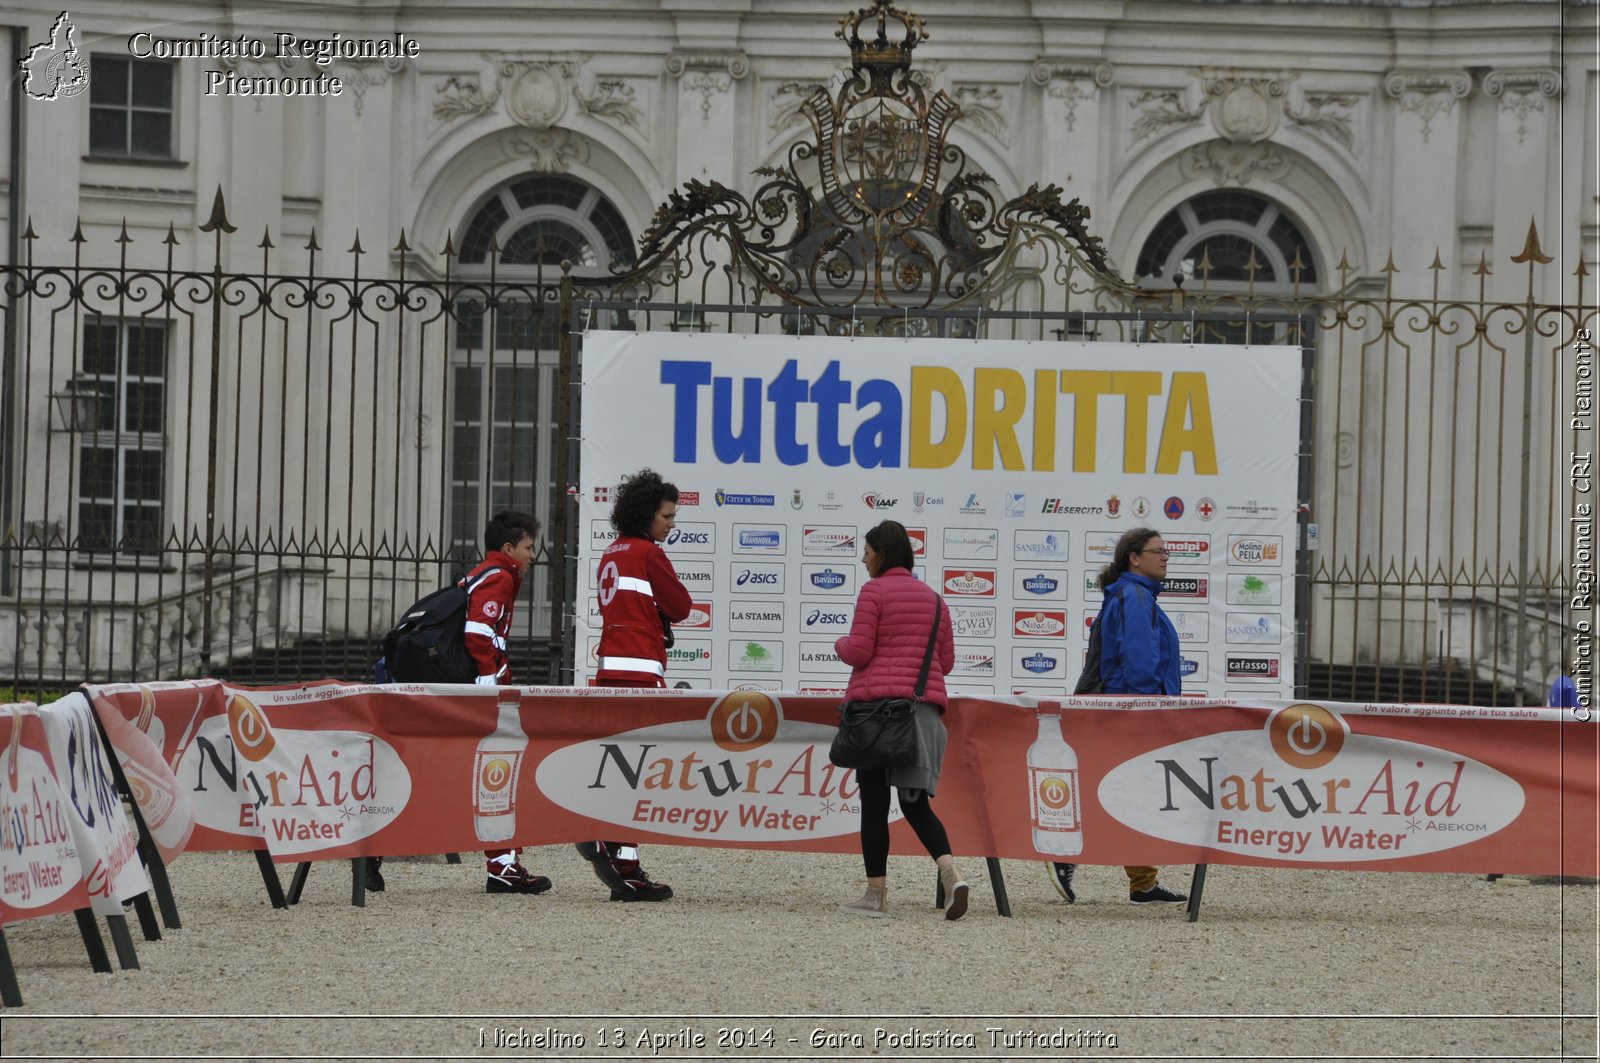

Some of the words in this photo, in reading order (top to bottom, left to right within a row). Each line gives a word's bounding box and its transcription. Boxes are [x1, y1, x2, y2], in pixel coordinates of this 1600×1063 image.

[876, 499, 898, 507] IAAF
[926, 497, 944, 505] Coni
[1058, 506, 1103, 515] ESERCITO
[1016, 543, 1056, 552] SANREMO
[1238, 542, 1262, 551] Molino
[1239, 551, 1261, 560] PEILA
[813, 576, 842, 584] Bavaria
[1160, 580, 1197, 590] afasso
[1026, 581, 1055, 590] Bavaria
[731, 612, 744, 620] LA
[745, 612, 782, 620] STAMPA
[951, 616, 994, 634] egway
[666, 648, 710, 661] attaglio
[801, 653, 814, 661] LA
[814, 654, 841, 662] STAM
[1024, 659, 1054, 668] Bavaria
[1180, 663, 1196, 671] aria
[1229, 660, 1268, 670] cafasso
[543, 686, 571, 694] valore
[573, 687, 612, 696] aggiunto
[614, 687, 629, 696] per
[273, 694, 284, 703] Un
[286, 693, 312, 702] valore
[1069, 698, 1082, 706] Un
[1084, 699, 1113, 707] valore
[1115, 699, 1157, 709] aggiunto
[1159, 699, 1177, 708] per
[1178, 698, 1188, 706] la
[1364, 704, 1378, 713] Un
[1380, 705, 1411, 714] valore
[1413, 706, 1457, 716] aggiunto
[1459, 709, 1475, 717] per
[1479, 708, 1488, 717] la
[1490, 708, 1507, 717] tua
[1509, 709, 1539, 718] salute
[1155, 757, 1466, 819] NaturAid
[359, 804, 395, 816] ABEKOM
[839, 804, 898, 816] ABM
[632, 800, 729, 834] Energy
[738, 804, 821, 831] Water
[271, 817, 344, 841] Water
[1425, 820, 1487, 832] ABEKOM
[1217, 820, 1312, 854] Energy
[1321, 825, 1407, 850] Water
[4, 865, 31, 901] Energy
[28, 861, 63, 889] Water
